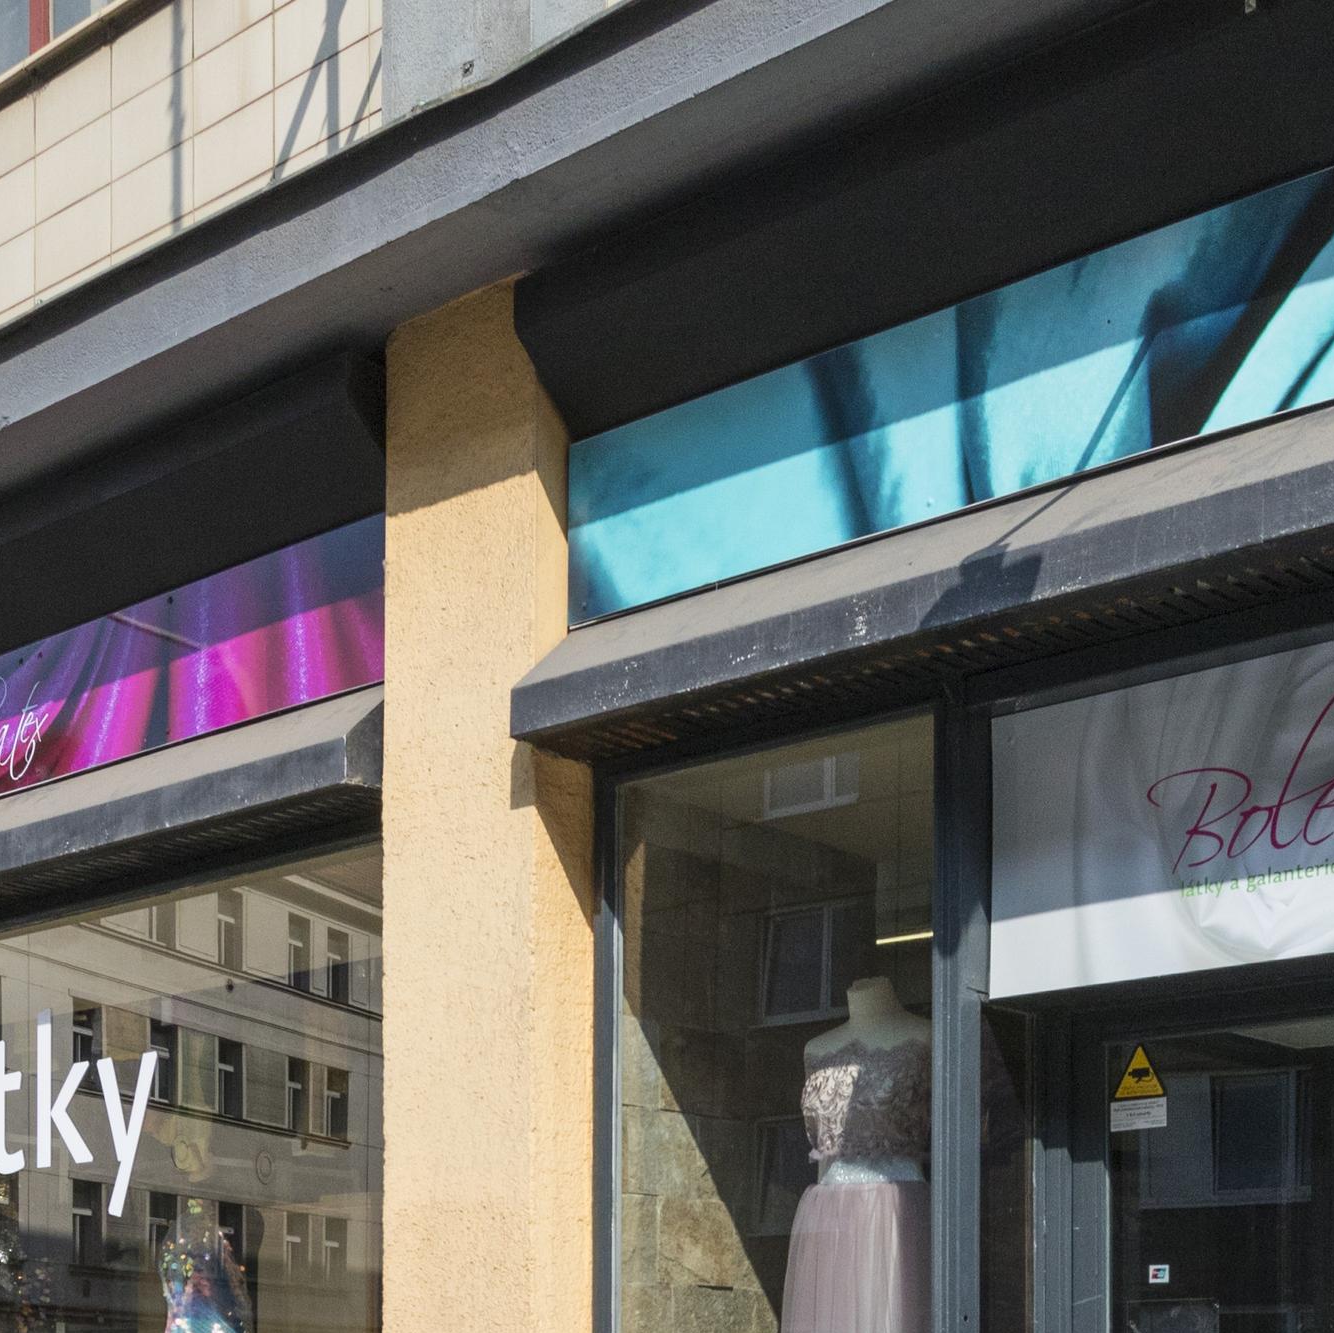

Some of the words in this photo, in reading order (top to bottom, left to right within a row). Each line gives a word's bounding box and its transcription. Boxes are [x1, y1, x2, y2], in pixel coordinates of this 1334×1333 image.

[10, 681, 48, 780] tex
[1180, 876, 1224, 898] látky
[1230, 879, 1240, 891] a
